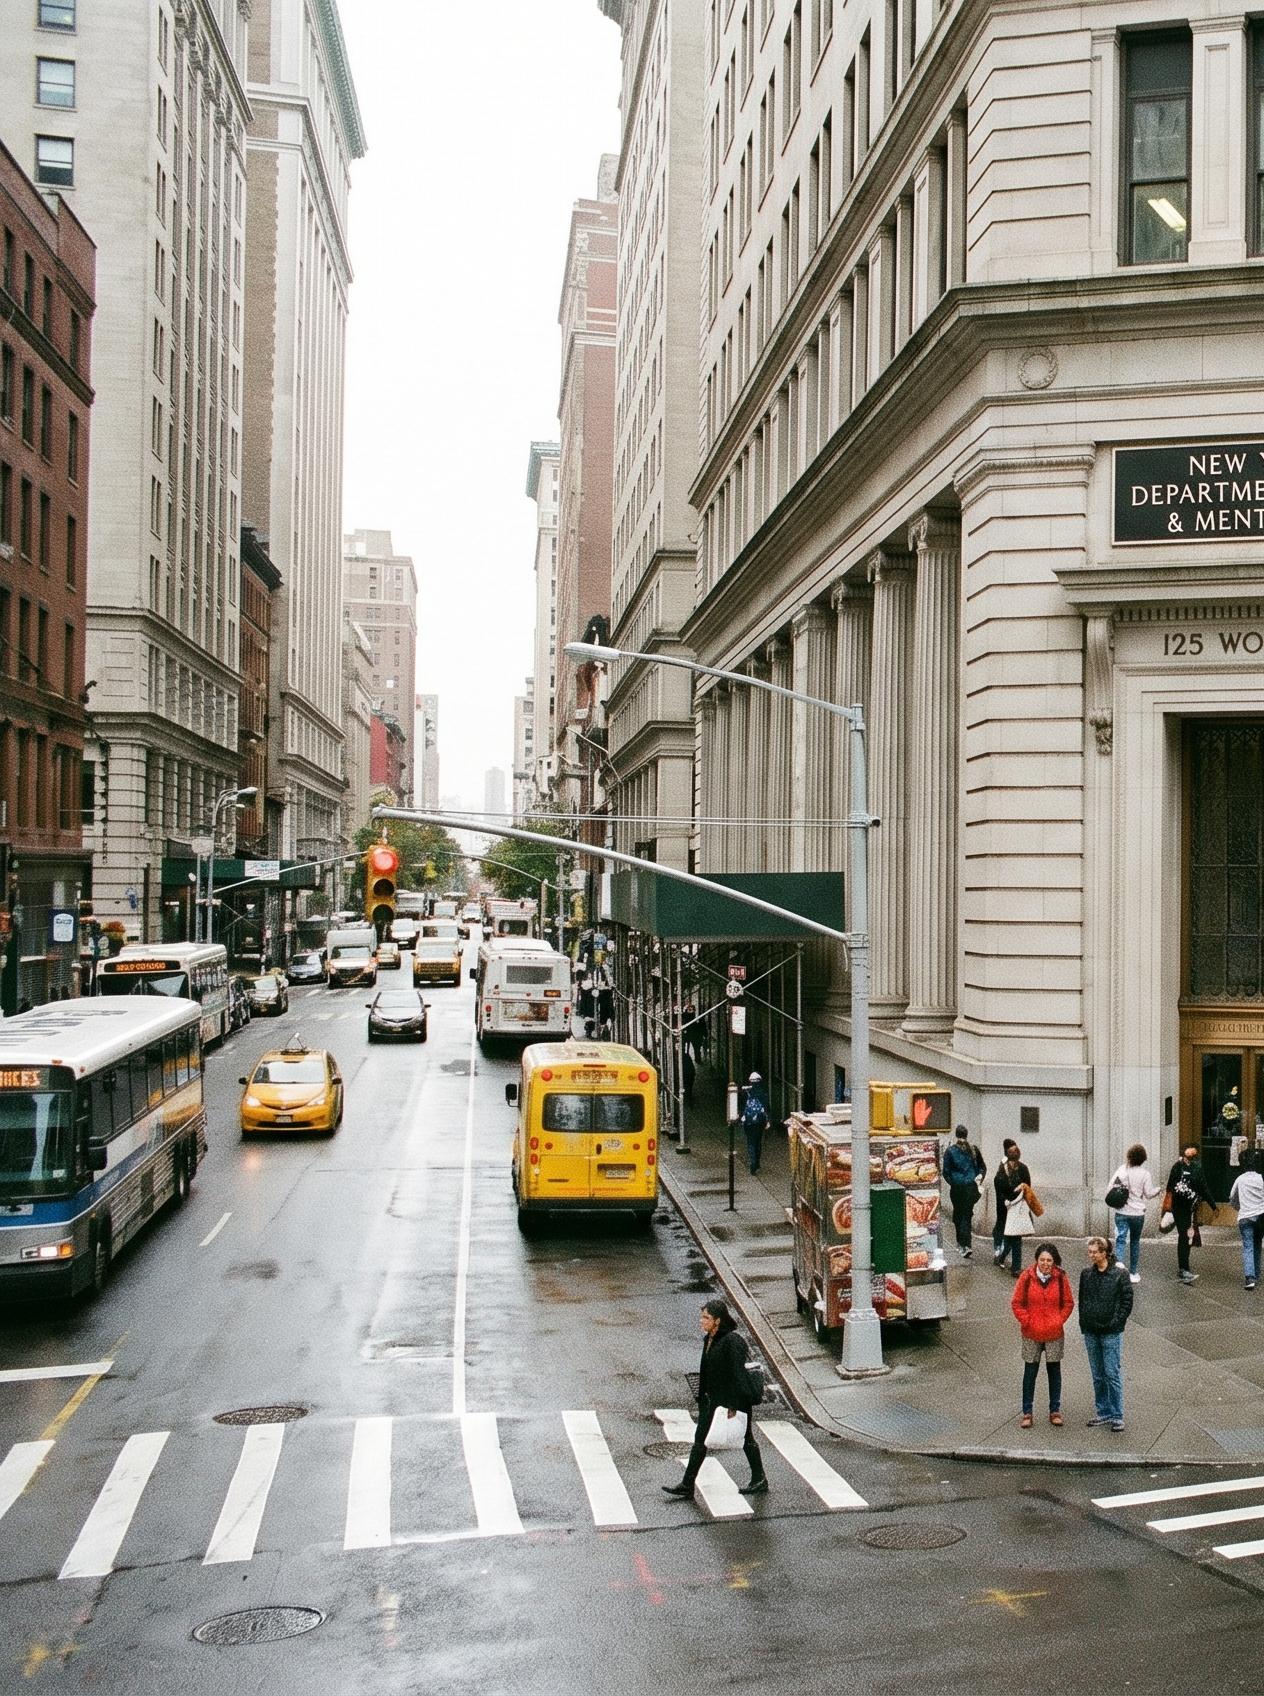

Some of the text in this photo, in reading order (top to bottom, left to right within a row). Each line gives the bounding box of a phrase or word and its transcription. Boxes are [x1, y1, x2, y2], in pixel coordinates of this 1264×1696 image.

[1189, 453, 1247, 476] NEW
[1167, 511, 1184, 533] &
[1163, 632, 1204, 656] 125
